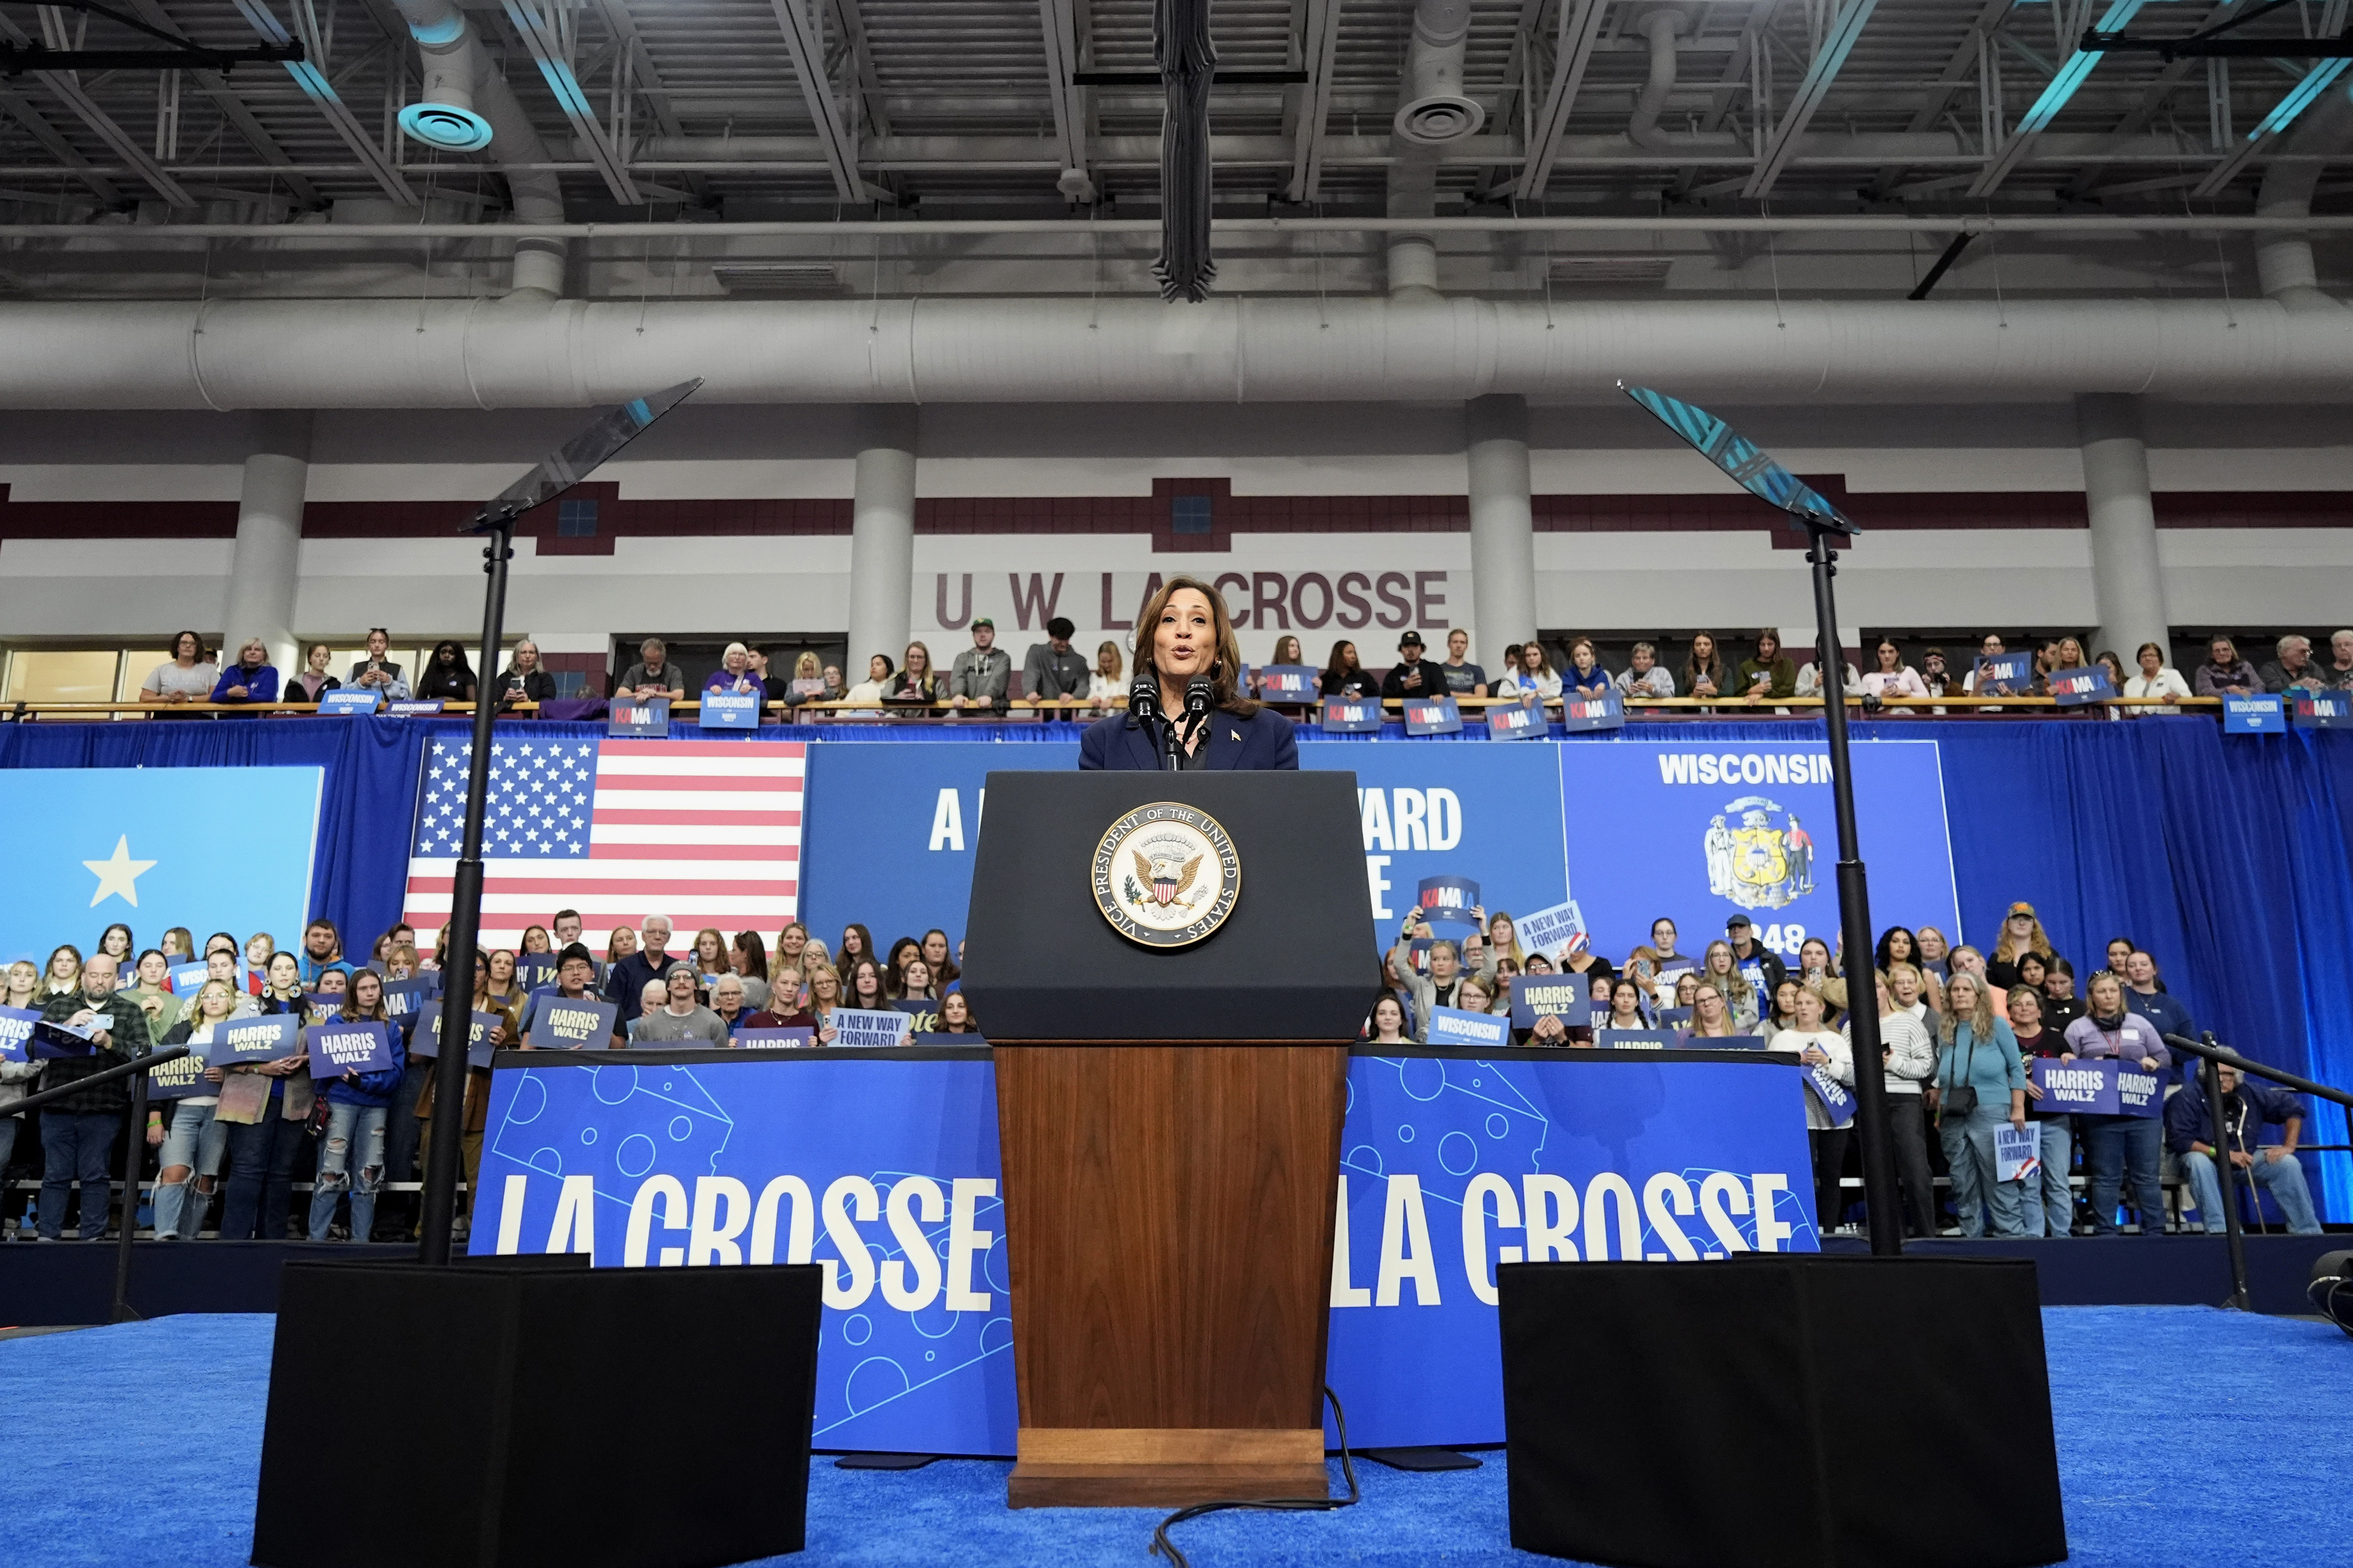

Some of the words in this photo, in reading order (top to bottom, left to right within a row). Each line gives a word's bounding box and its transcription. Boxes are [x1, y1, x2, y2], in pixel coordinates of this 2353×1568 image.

[937, 573, 972, 630] U
[1009, 573, 1064, 630] W
[1213, 572, 1449, 630] CROSSE
[2055, 674, 2107, 695] KAMALA
[327, 694, 375, 704] WISCONSIN
[391, 703, 438, 712] WISCONSIN
[707, 696, 754, 709] WISCONSIN
[2229, 700, 2278, 713] WISCONSIN
[2299, 699, 2348, 717] KAMALA
[616, 707, 662, 724] KAMALA
[1329, 705, 1374, 722] KAMALA
[1409, 707, 1454, 724] KAMALA
[1494, 707, 1541, 730] KAMALA
[1570, 700, 1617, 719] KAMALA
[1658, 754, 1834, 784] WISCONSIN
[929, 788, 965, 851] A
[1147, 809, 1163, 820] OF
[1170, 809, 1194, 823] THE
[1357, 788, 1462, 851] ARD
[1095, 814, 1138, 894] PRESIDENT
[1200, 820, 1236, 878] UNITED
[1421, 887, 1474, 909] KAMALA
[1104, 901, 1136, 936] VICE
[1187, 888, 1234, 938] STATES
[1523, 923, 1531, 936] A
[1532, 914, 1555, 932] NEW
[1554, 907, 1575, 925] WAY
[1531, 922, 1578, 949] FORWARD
[1525, 986, 1575, 1006] HARRIS
[548, 1008, 599, 1031] HARRIS
[1533, 1003, 1568, 1016] WALZ
[837, 1014, 844, 1028] A
[848, 1015, 874, 1030] NEW
[877, 1016, 902, 1032] WAY
[1438, 1016, 1501, 1041] WISCONSIN
[227, 1024, 282, 1045] HARRIS
[321, 1032, 376, 1054] HARRIS
[553, 1026, 589, 1041] WALZ
[840, 1030, 895, 1047] FORWARD
[234, 1040, 273, 1052] WALZ
[149, 1055, 204, 1077] HARRIS
[331, 1050, 371, 1065] WALZ
[156, 1074, 196, 1087] WALZ
[1811, 1068, 1836, 1105] WALZ
[2045, 1069, 2104, 1091] HARRIS
[2118, 1072, 2157, 1096] HARRIS
[2054, 1089, 2095, 1102] WALZ
[2122, 1092, 2148, 1106] WALZ
[2002, 1129, 2016, 1145] NEW
[2017, 1128, 2035, 1142] WAY
[2001, 1145, 2032, 1163] FORWARD
[624, 1174, 997, 1311] CROSSE
[1330, 1174, 1441, 1307] LA
[1462, 1172, 1791, 1306] CROSSE
